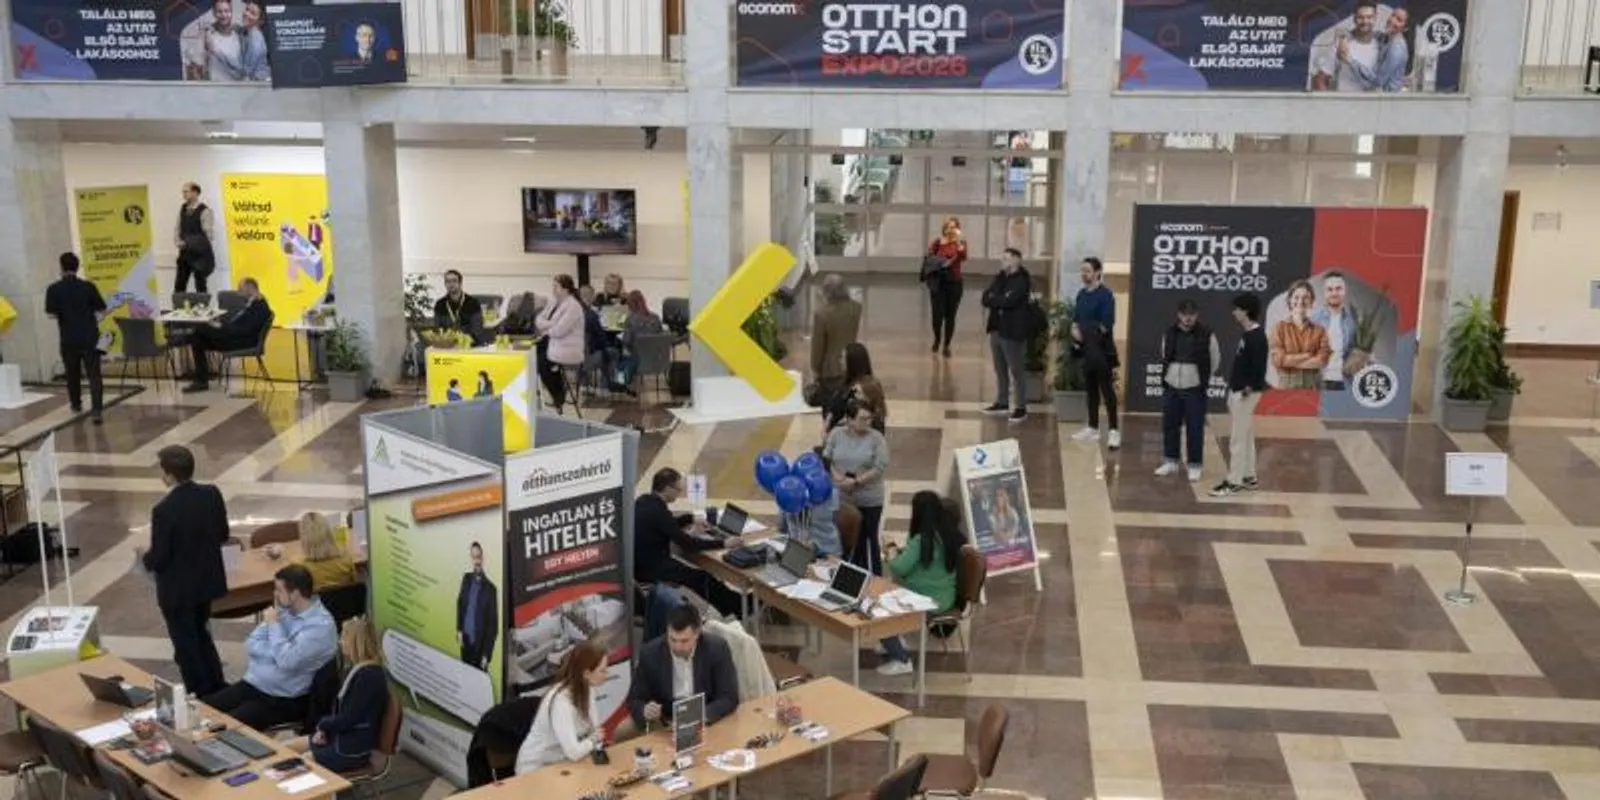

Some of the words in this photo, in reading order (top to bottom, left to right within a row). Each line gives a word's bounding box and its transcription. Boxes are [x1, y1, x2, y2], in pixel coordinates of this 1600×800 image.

[80, 8, 127, 19] TALÁLD
[129, 9, 156, 19] MEG
[822, 4, 967, 29] OTTHON
[1201, 14, 1256, 26] TALÁLD
[1258, 16, 1287, 26] MEG
[106, 23, 123, 33] AZ
[124, 23, 156, 33] UTAT
[84, 34, 117, 46] ELSŐ
[118, 34, 158, 46] SAJÁT
[1229, 30, 1248, 39] AZ
[1250, 30, 1286, 40] UTAT
[822, 30, 966, 54] START
[1202, 42, 1238, 53] ELSŐ
[1240, 42, 1285, 54] SAJÁT
[76, 47, 160, 59] LAKÁSODHOZ
[821, 55, 967, 75] EXPO2026
[1189, 55, 1285, 67] LAKÁSODHOZ
[232, 200, 272, 213] Váltsd
[1153, 234, 1270, 255] OTTHON
[1152, 254, 1269, 275] START
[1152, 274, 1268, 292] EXPO2026
[1365, 373, 1387, 386] fix
[523, 459, 612, 491] otthonszakértő
[523, 503, 596, 533] INGATLAN
[599, 496, 615, 515] ÉS
[525, 515, 617, 558] HITELEK
